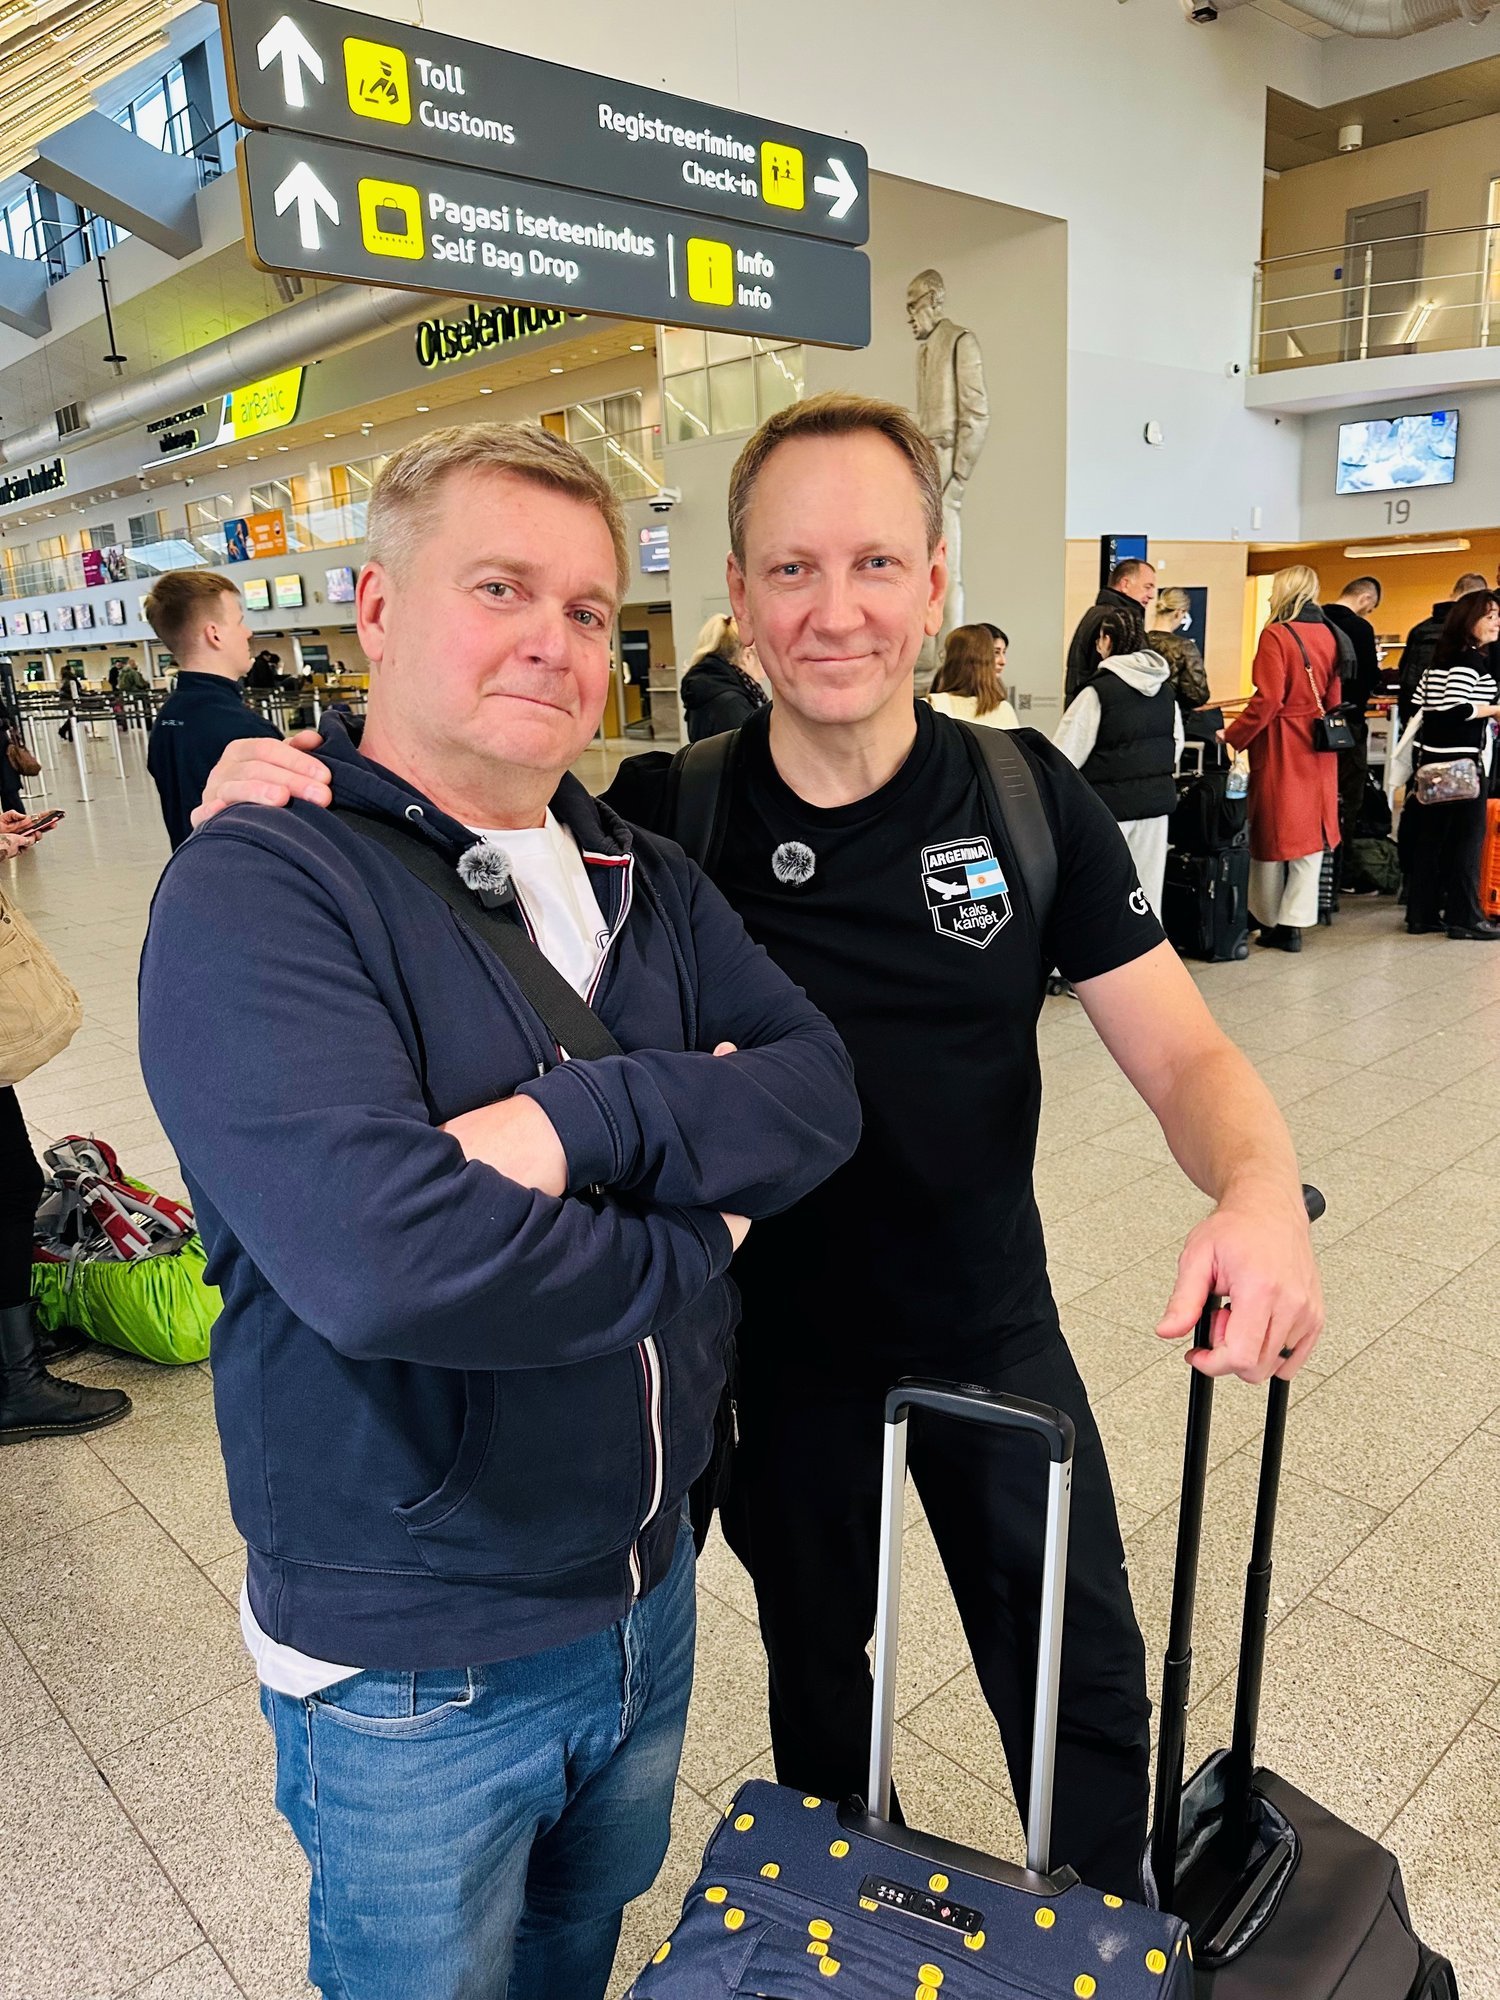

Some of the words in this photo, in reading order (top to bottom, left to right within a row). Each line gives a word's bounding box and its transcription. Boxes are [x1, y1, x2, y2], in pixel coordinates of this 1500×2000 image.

[414, 58, 465, 95] Toll
[419, 101, 516, 145] Customs
[598, 104, 757, 164] Registreerimine
[682, 161, 758, 198] Check-in
[428, 193, 510, 233] Pagasi
[515, 207, 655, 258] iseteenindus
[431, 235, 477, 265] Self
[482, 244, 525, 278] Bag
[529, 252, 580, 285] Drop
[736, 250, 775, 279] Info
[737, 284, 772, 310] Info
[240, 387, 286, 424] airBaltic
[1383, 499, 1411, 525] 19
[952, 911, 1000, 932] kanget
[958, 903, 989, 919] kaks
